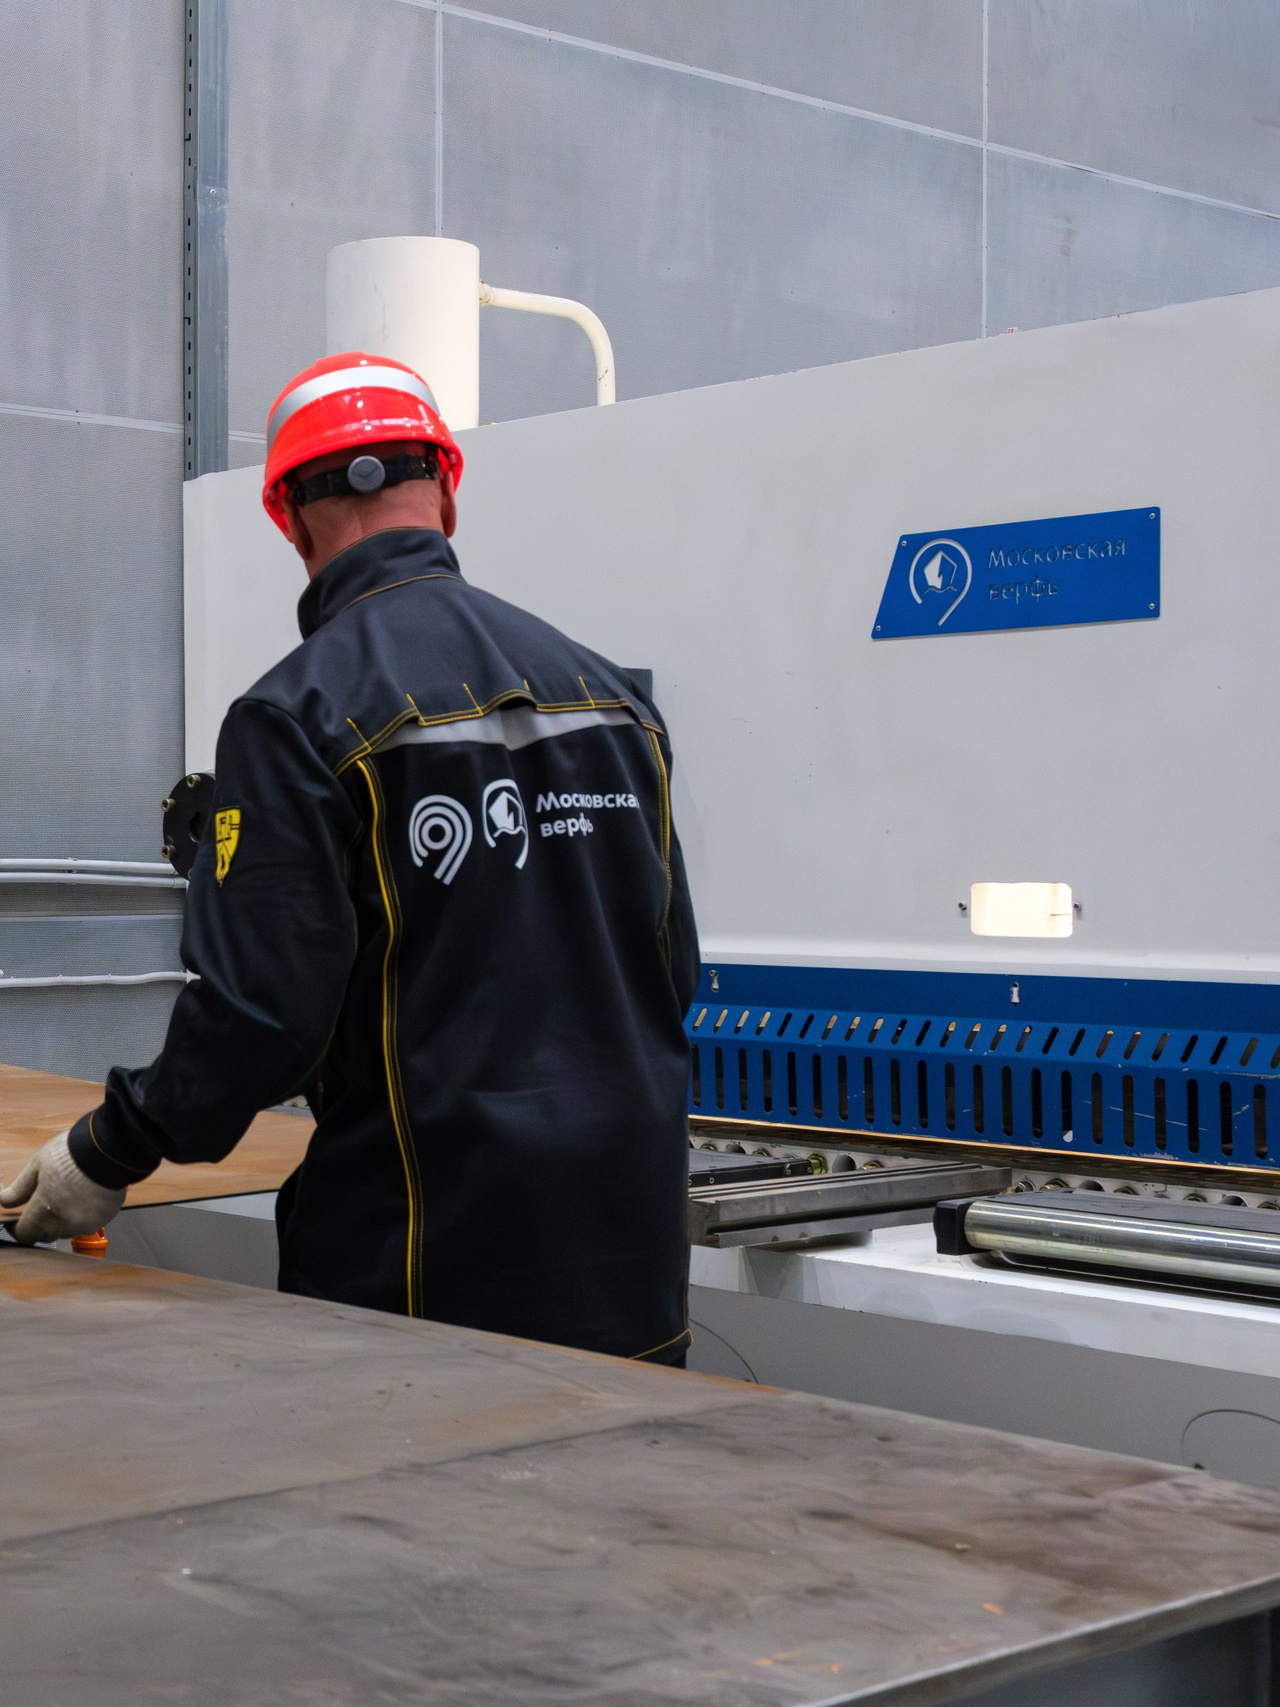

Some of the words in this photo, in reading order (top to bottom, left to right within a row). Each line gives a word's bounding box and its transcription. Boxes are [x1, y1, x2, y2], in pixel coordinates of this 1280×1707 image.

[988, 539, 1125, 568] Московская
[989, 574, 1058, 604] верфь
[536, 791, 640, 813] Московска
[540, 812, 594, 837] верфь
